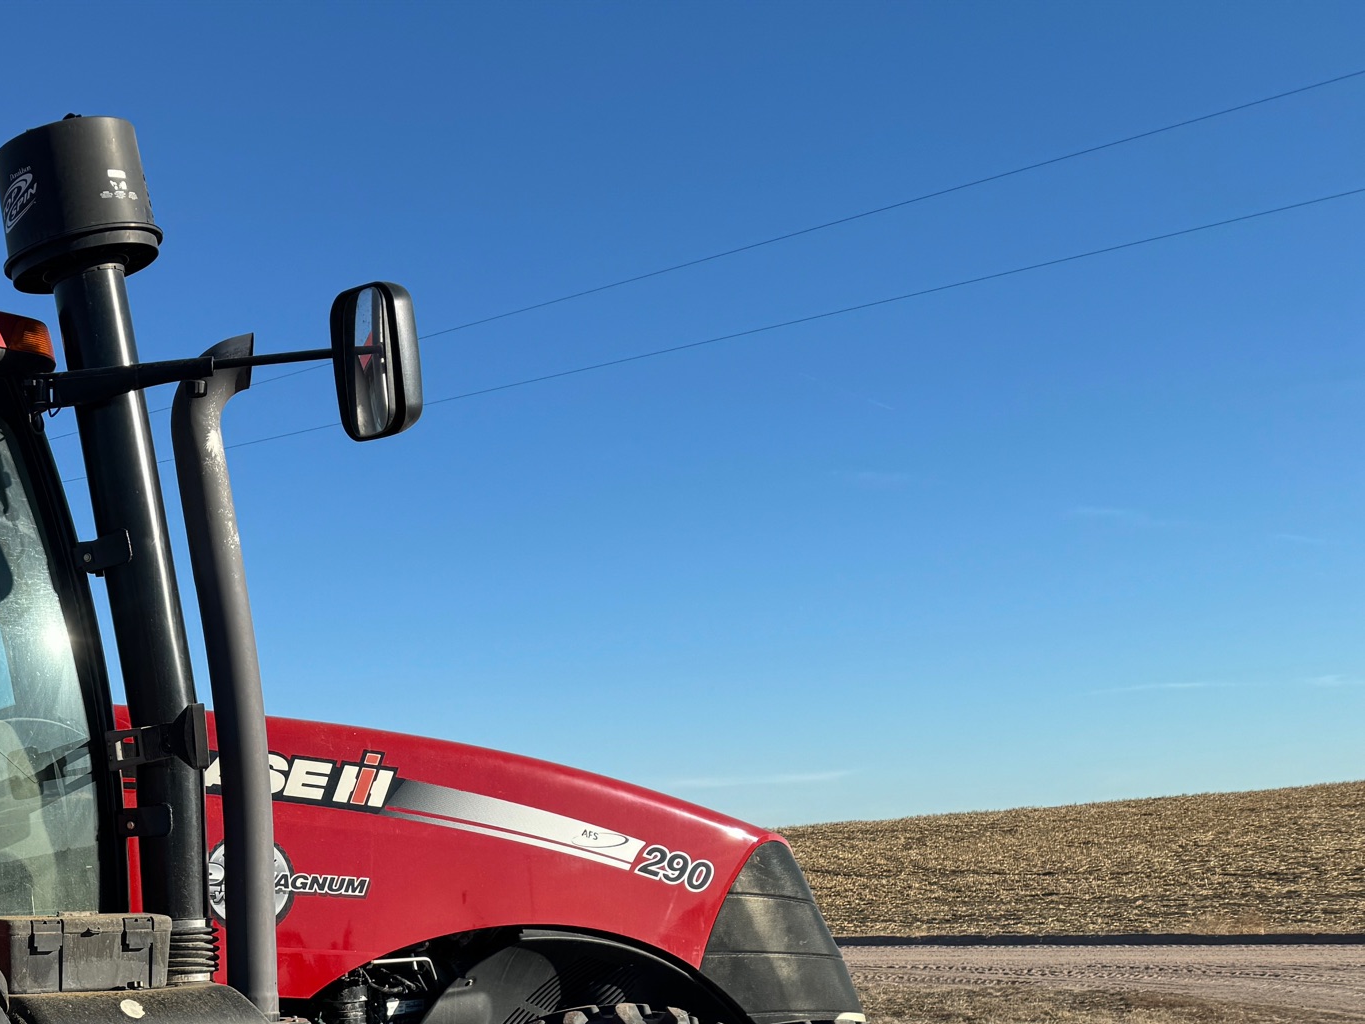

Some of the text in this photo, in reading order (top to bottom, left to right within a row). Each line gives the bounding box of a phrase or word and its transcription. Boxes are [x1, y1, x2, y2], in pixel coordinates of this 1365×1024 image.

[11, 182, 38, 219] SPIN
[581, 828, 599, 841] AFS
[636, 846, 713, 891] 290
[275, 873, 370, 896] AGNUM
